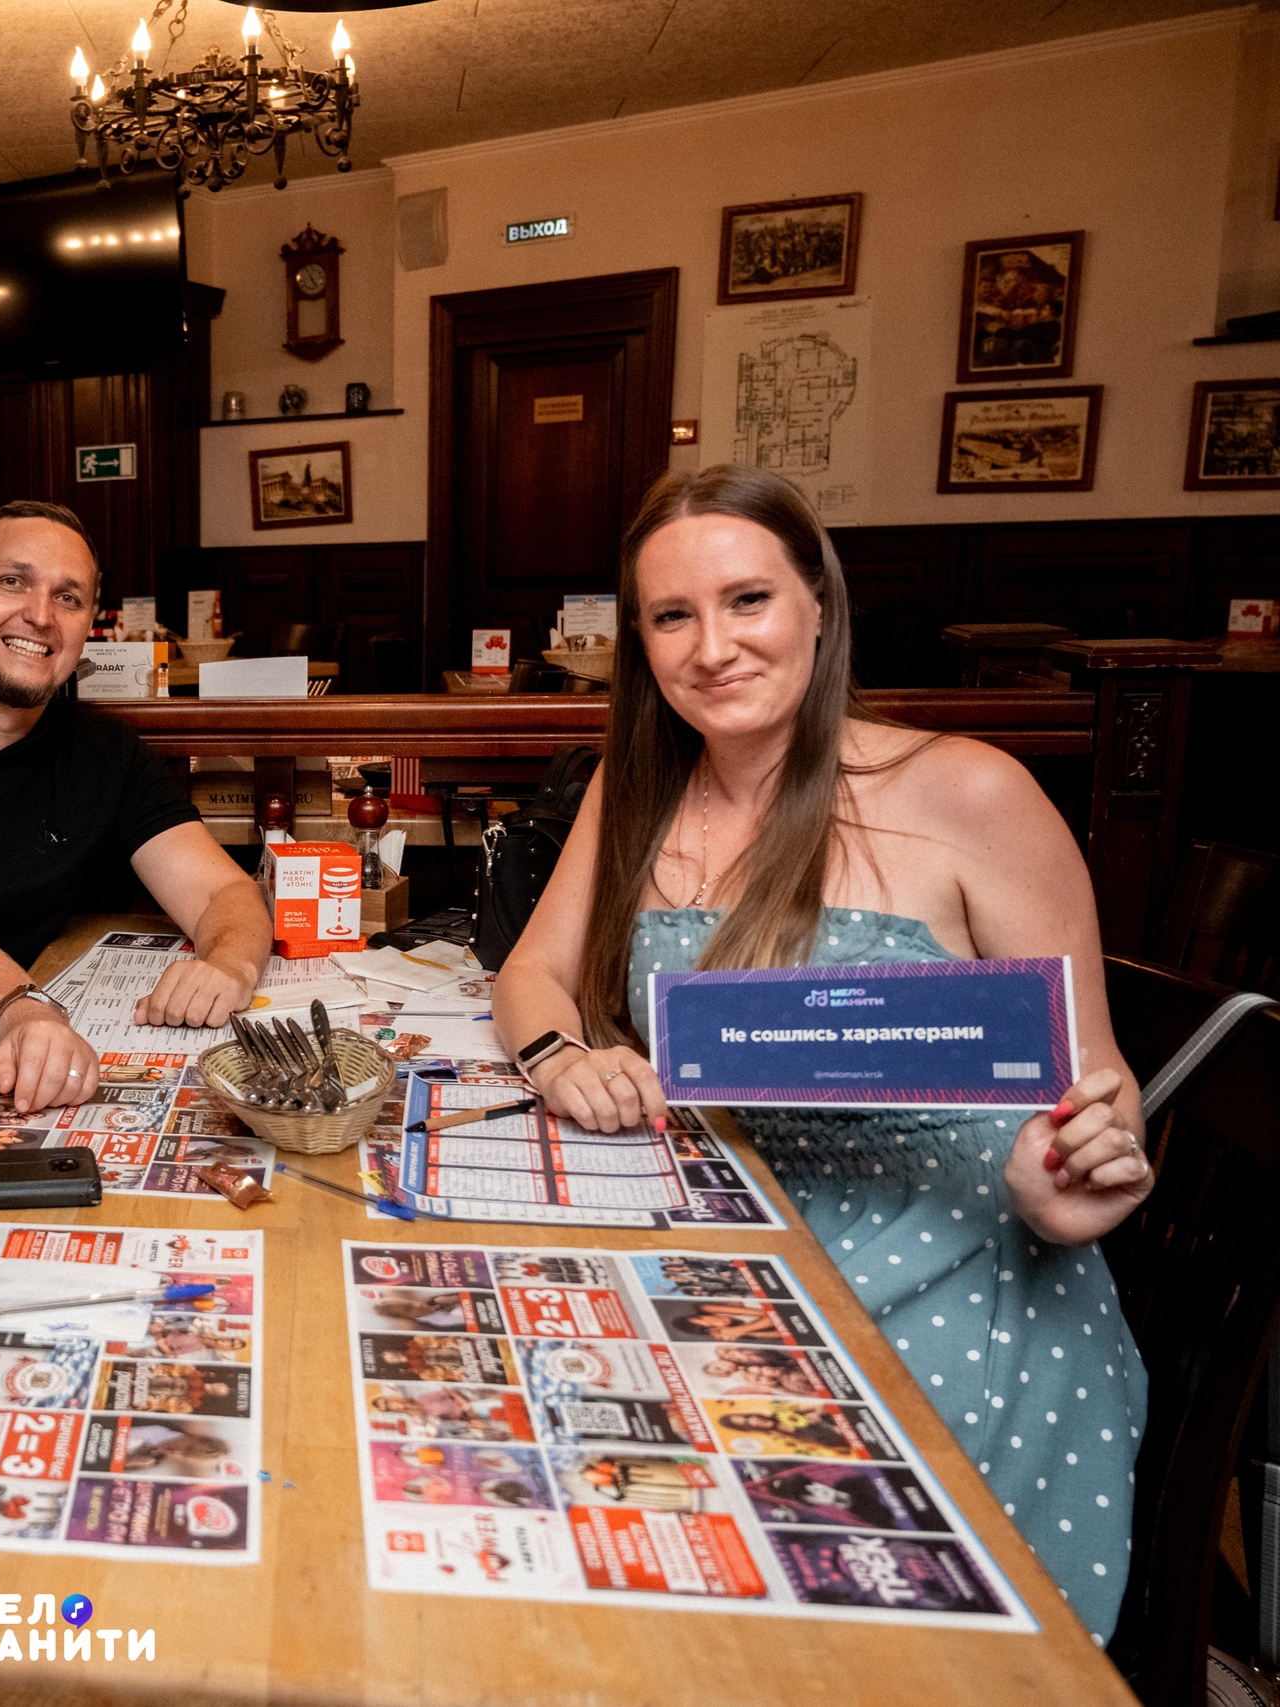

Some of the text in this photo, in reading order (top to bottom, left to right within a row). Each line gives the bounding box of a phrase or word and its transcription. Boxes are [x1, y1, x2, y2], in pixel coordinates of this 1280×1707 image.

[509, 218, 568, 241] ВЫХОД
[96, 663, 125, 672] RARAT
[829, 987, 867, 997] МЕЛО
[830, 997, 885, 1007] МАНИТИ
[720, 1025, 985, 1044] Не сошлись характерами
[813, 1070, 885, 1079] @meloman.krsk
[521, 1287, 578, 1337] 2=3
[650, 1349, 713, 1444] MAXIMILIANS.RU
[843, 1533, 925, 1607] ТРЕК
